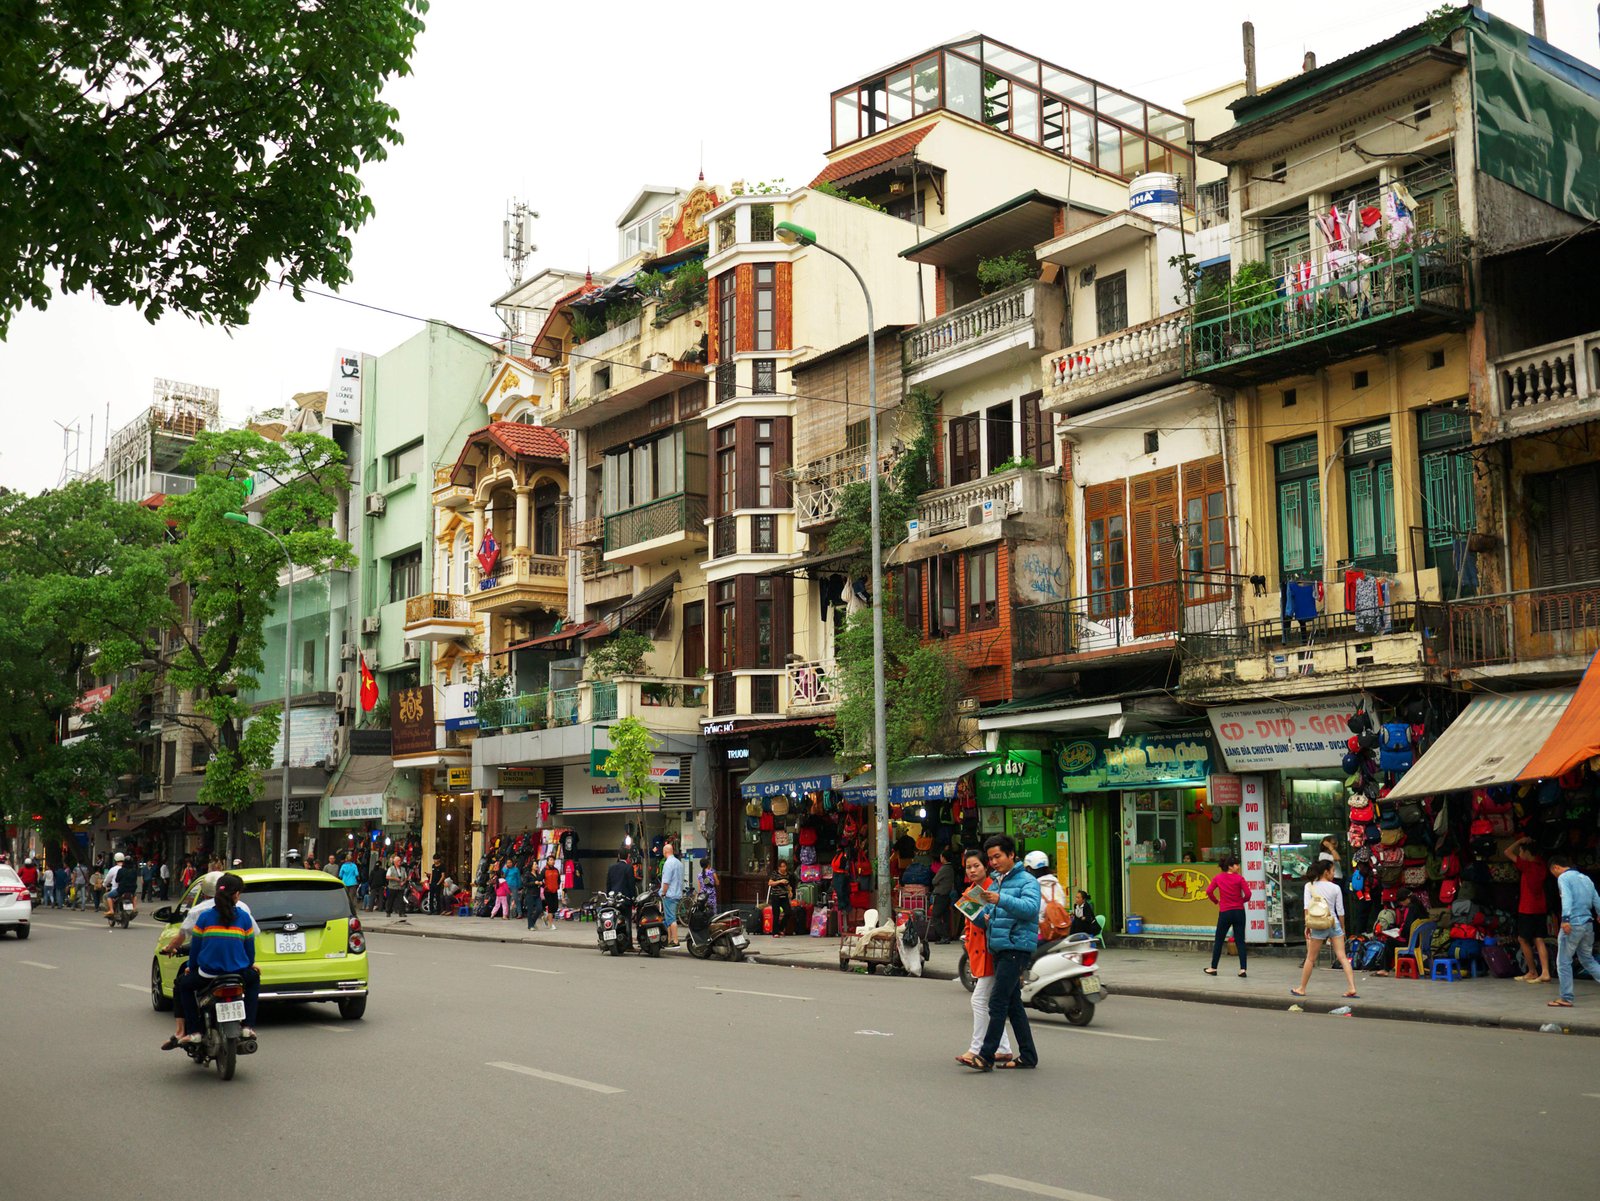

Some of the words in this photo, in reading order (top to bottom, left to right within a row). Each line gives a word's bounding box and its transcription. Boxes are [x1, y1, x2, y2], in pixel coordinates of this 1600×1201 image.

[463, 690, 480, 708] BID
[1219, 722, 1244, 741] CD
[1256, 718, 1296, 739] DVD
[1308, 713, 1352, 736] GAM
[1275, 742, 1291, 753] DÙN
[1295, 741, 1325, 752] BETACAM
[1005, 759, 1024, 776] day
[801, 780, 821, 793] VALY
[928, 785, 942, 796] SHOP
[1246, 783, 1256, 794] CD
[1245, 803, 1259, 813] DVD
[1247, 821, 1259, 832] Wii
